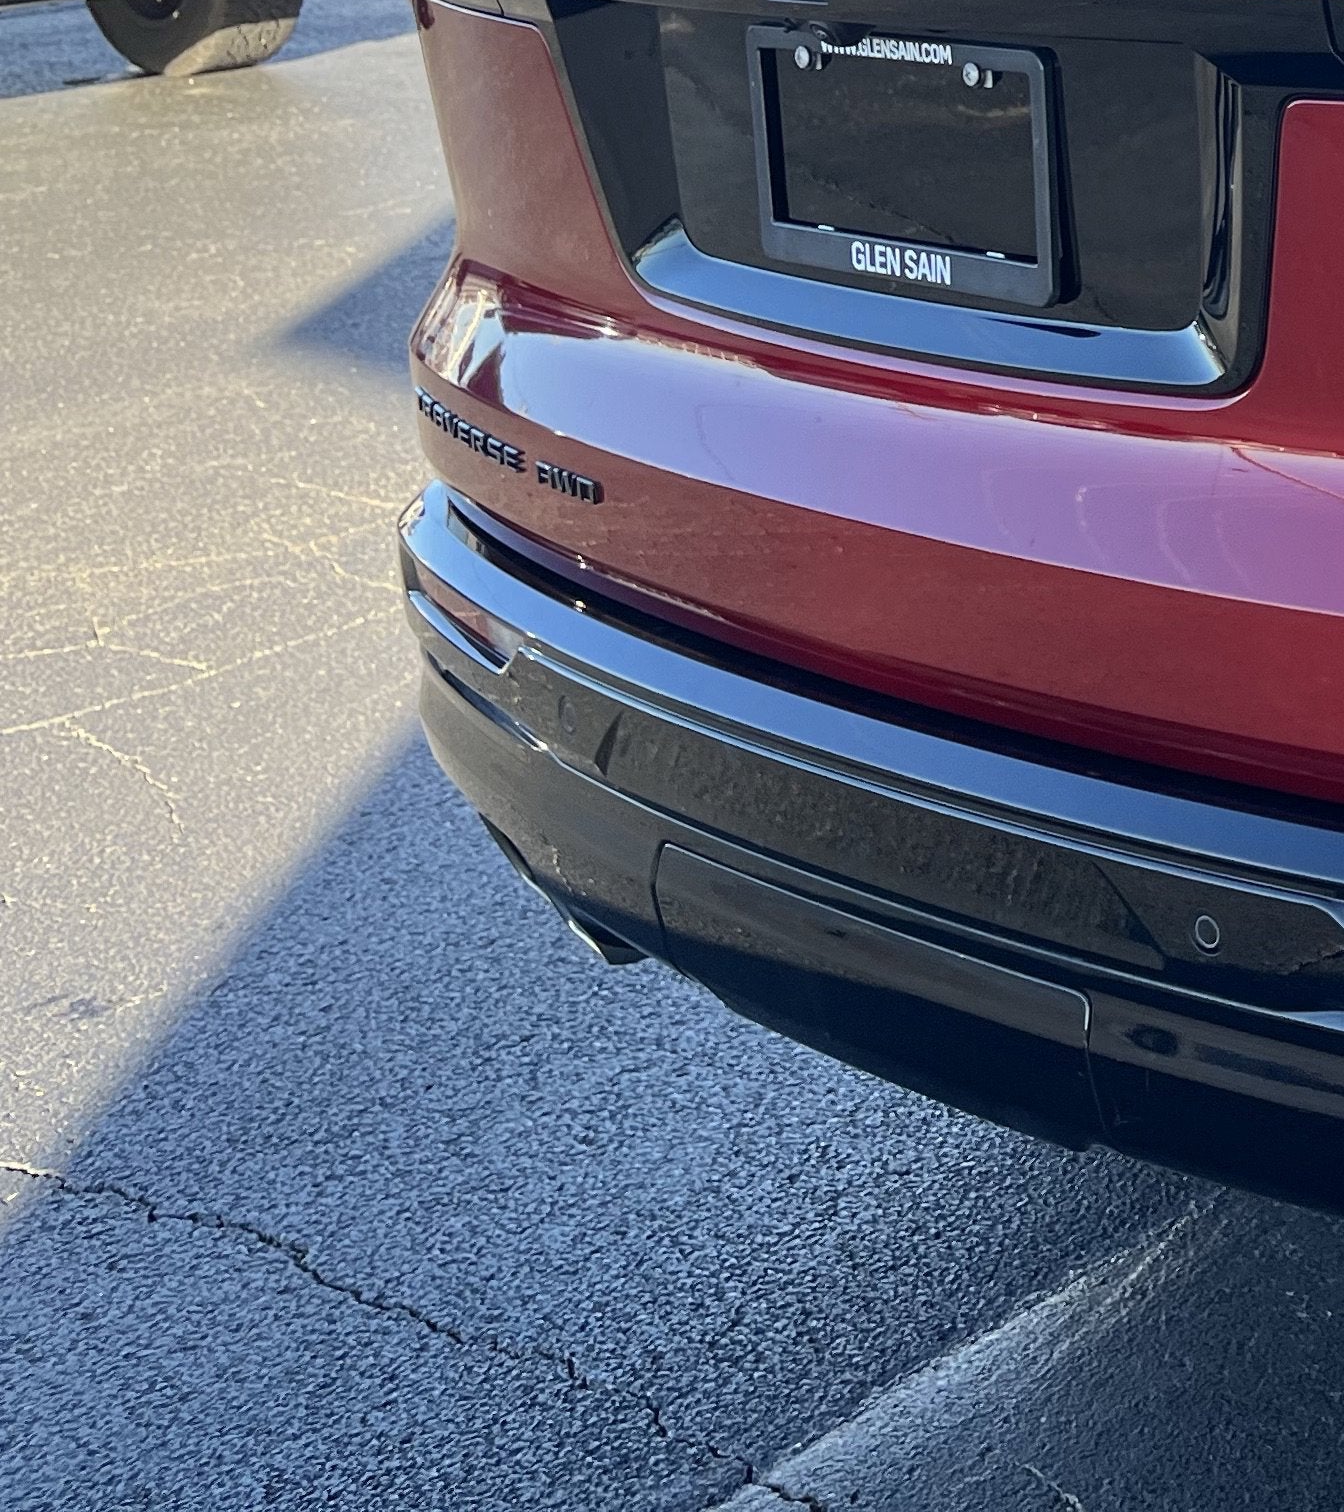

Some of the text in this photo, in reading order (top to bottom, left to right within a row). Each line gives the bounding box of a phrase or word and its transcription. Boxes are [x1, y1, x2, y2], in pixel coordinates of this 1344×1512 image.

[851, 240, 951, 286] GLEN SAIN
[535, 460, 604, 505] AWD
